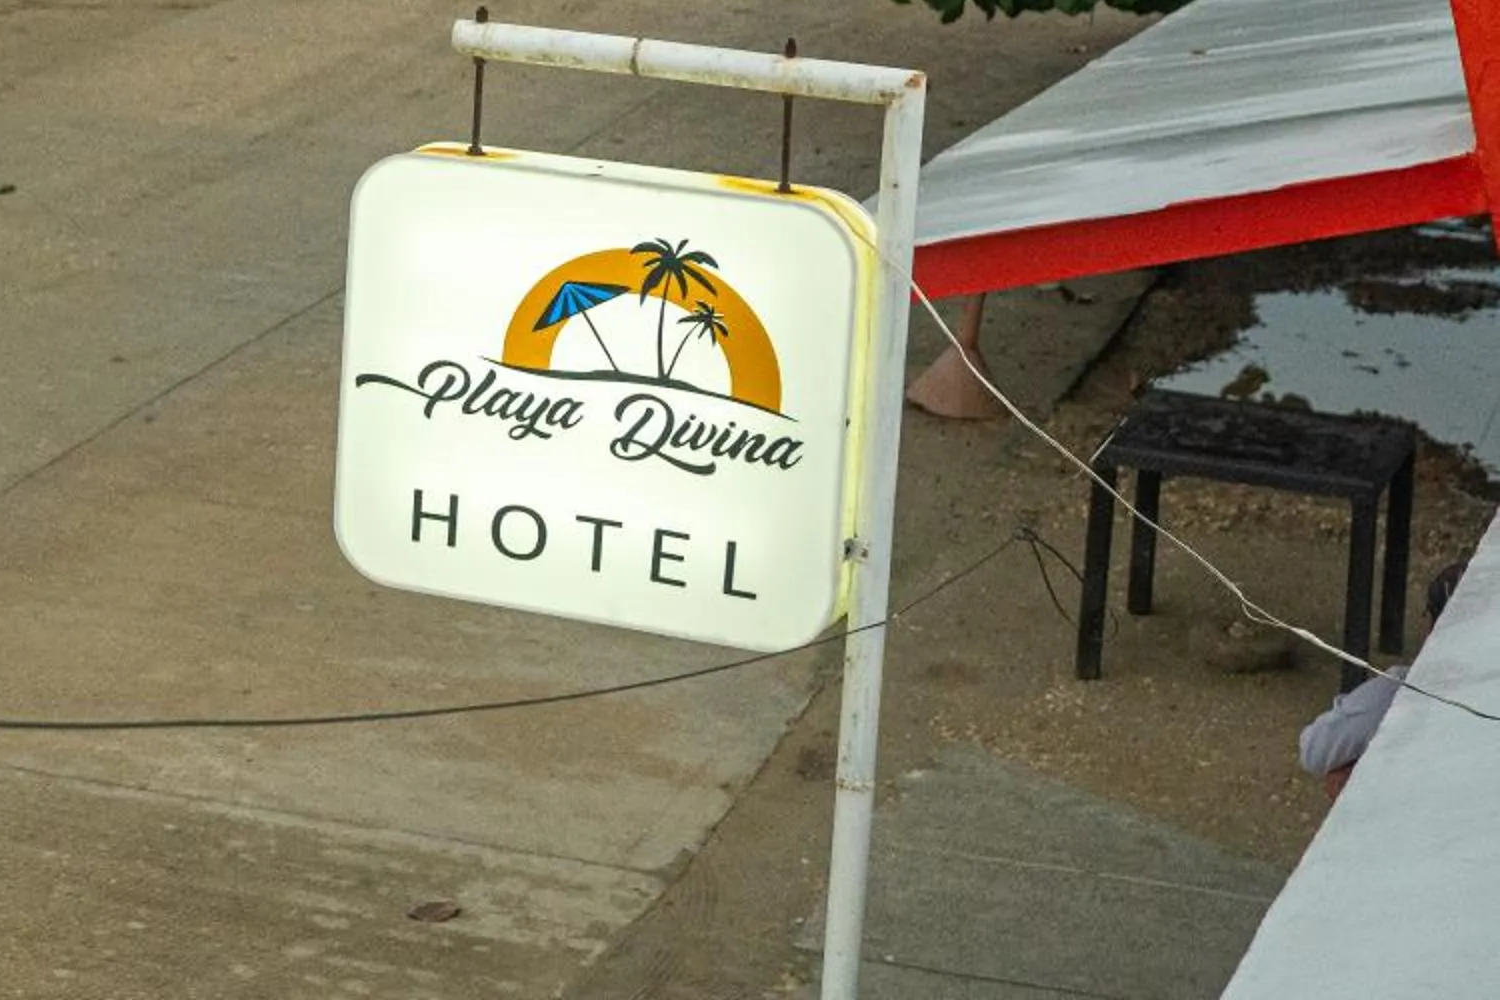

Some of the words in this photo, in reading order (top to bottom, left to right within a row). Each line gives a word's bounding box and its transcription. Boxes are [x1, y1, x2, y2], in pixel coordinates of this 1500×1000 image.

[355, 359, 584, 441] Playa
[609, 392, 805, 476] Divina
[411, 488, 758, 600] HOTEL
